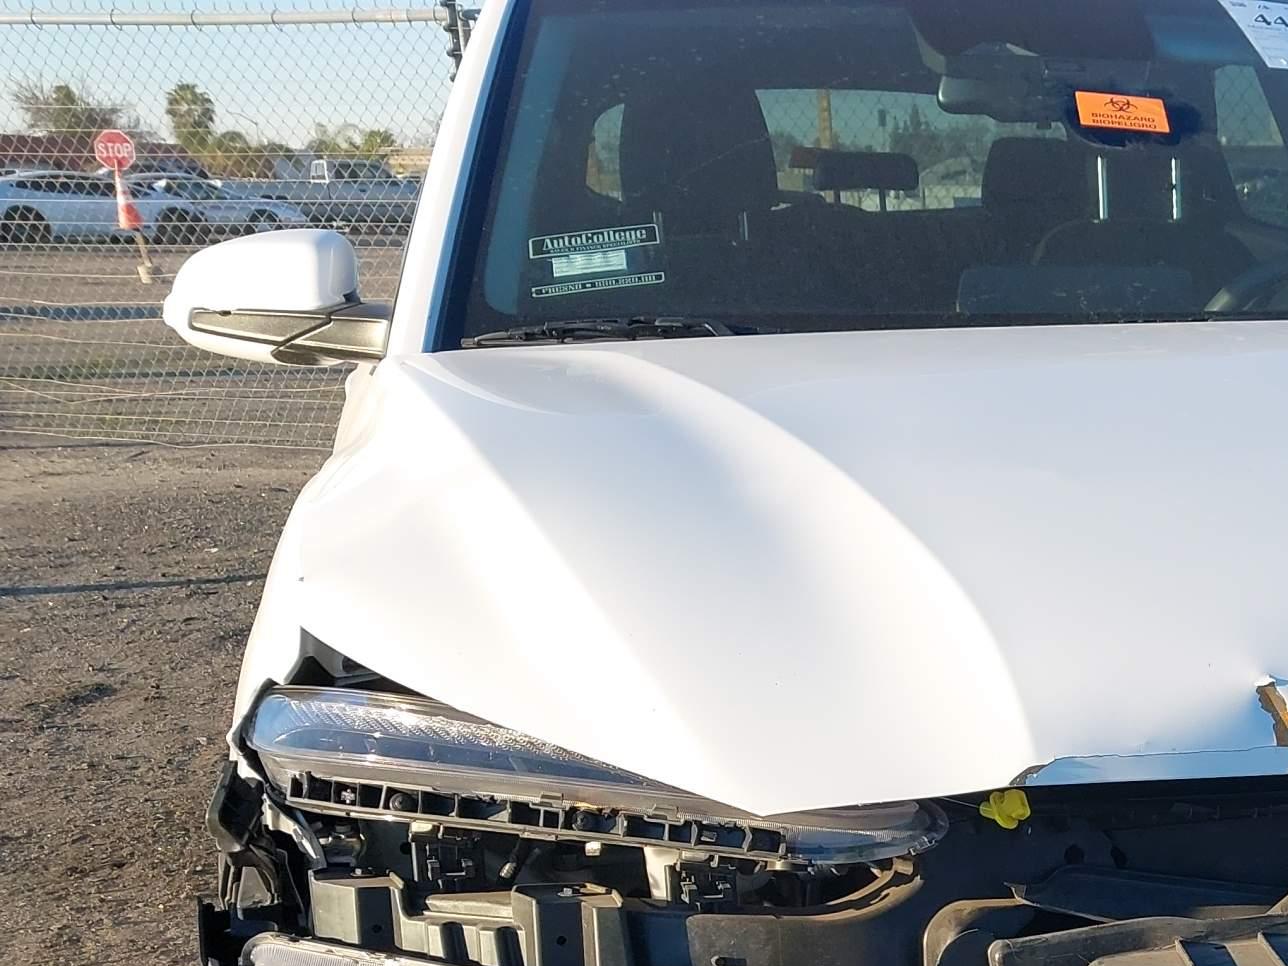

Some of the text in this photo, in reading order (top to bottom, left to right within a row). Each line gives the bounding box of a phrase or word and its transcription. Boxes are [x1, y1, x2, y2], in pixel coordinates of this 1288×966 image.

[1091, 112, 1156, 123] BIOHAZARD
[1091, 118, 1157, 129] BIOPELIGRO
[97, 142, 132, 158] STOP
[542, 228, 647, 251] AutoCollege
